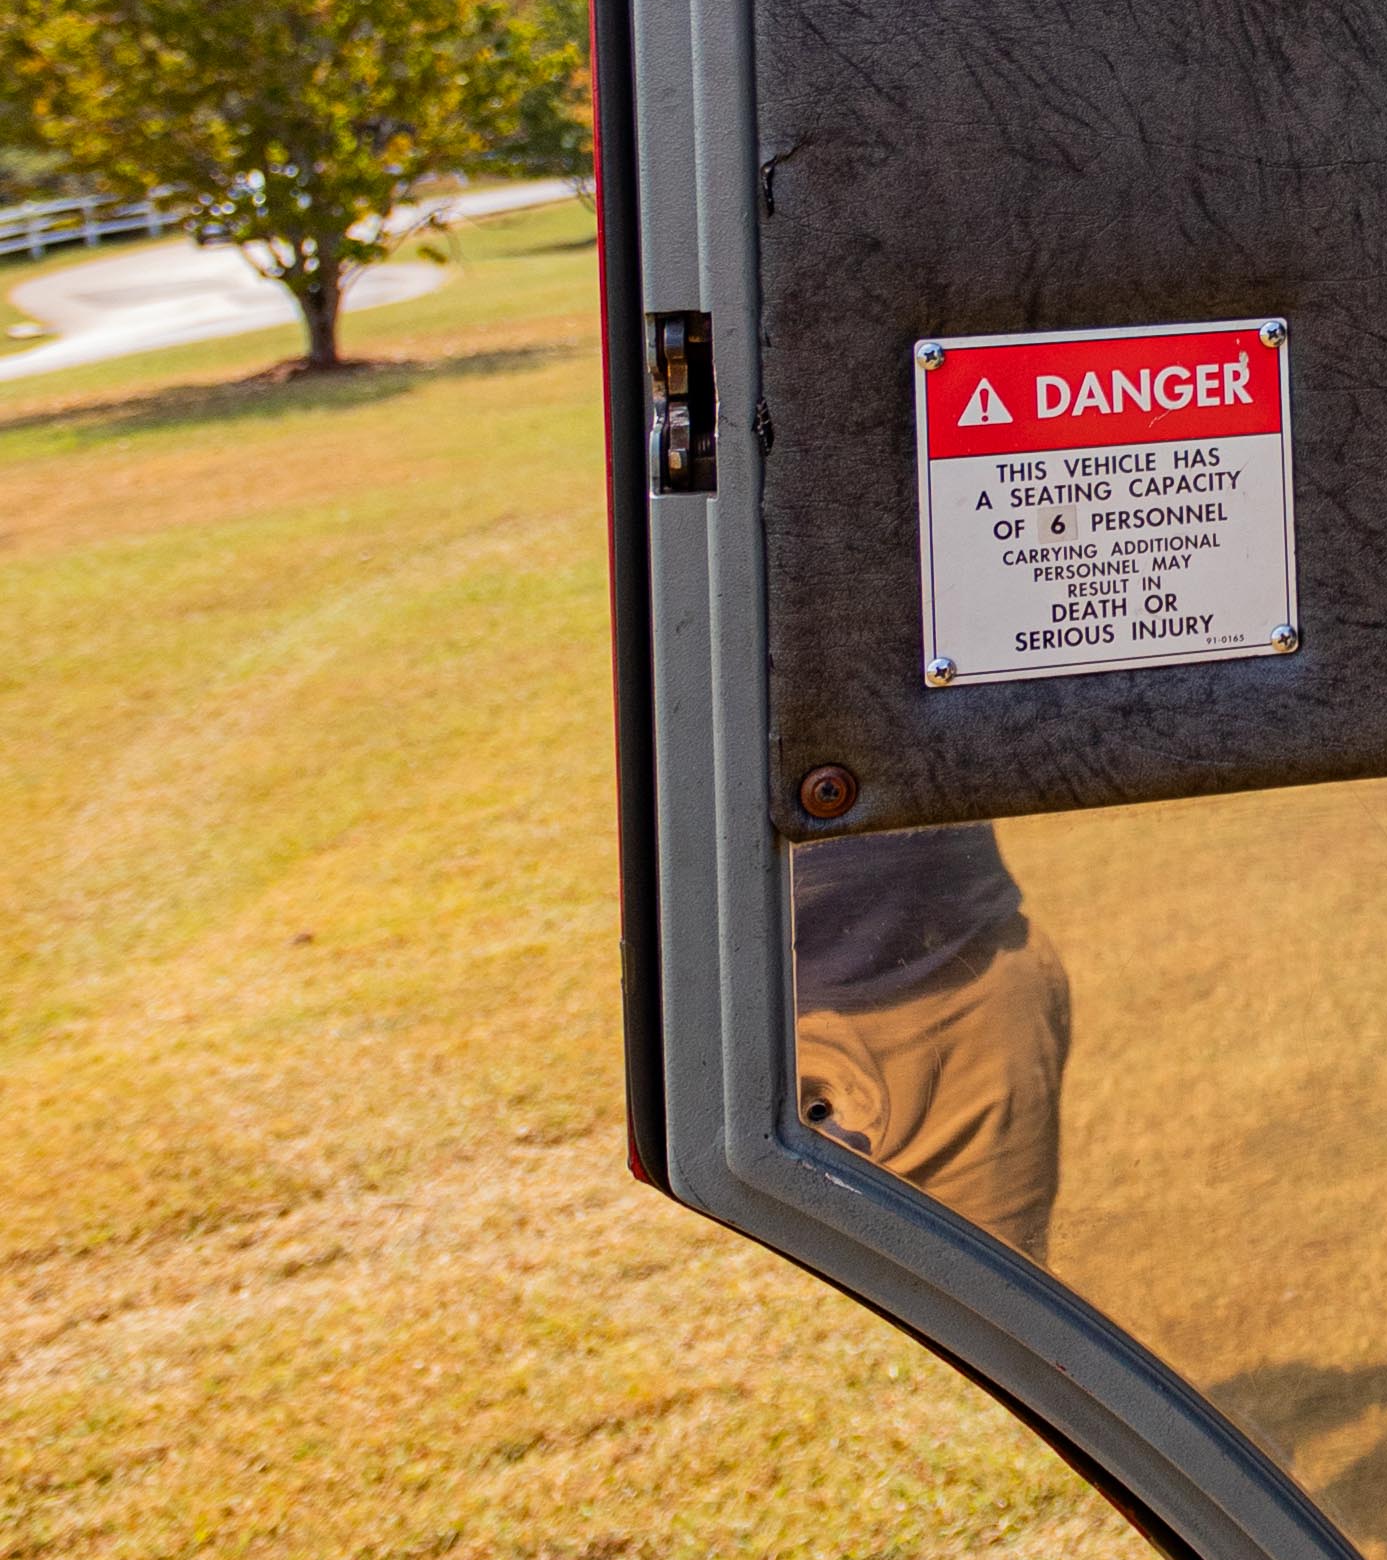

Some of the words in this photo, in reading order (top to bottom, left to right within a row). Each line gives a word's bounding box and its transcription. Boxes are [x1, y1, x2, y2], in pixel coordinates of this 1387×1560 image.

[1035, 361, 1254, 420] DANGER
[996, 461, 1047, 483] THIS
[1064, 452, 1157, 478] VEHICLE
[1174, 447, 1221, 470] HAS
[975, 491, 993, 511] A
[1010, 481, 1112, 509] SEATING
[1128, 470, 1241, 498] CAPACITY
[993, 519, 1026, 540] OF
[1050, 514, 1066, 535] 6
[1091, 502, 1228, 533] PERSONNEL
[1002, 544, 1098, 566] CARRYING
[1111, 533, 1221, 557] ADDITIONAL
[1033, 560, 1139, 583] PERSONNEL
[1151, 555, 1192, 572] MAY
[1068, 579, 1129, 598] RESULT
[1142, 576, 1162, 592] IN
[1051, 599, 1128, 623] DEATH
[1144, 593, 1178, 613] OR
[1015, 624, 1115, 652] SERIOUS
[1132, 614, 1215, 641] INJURY
[1206, 634, 1245, 645] 91-0165
